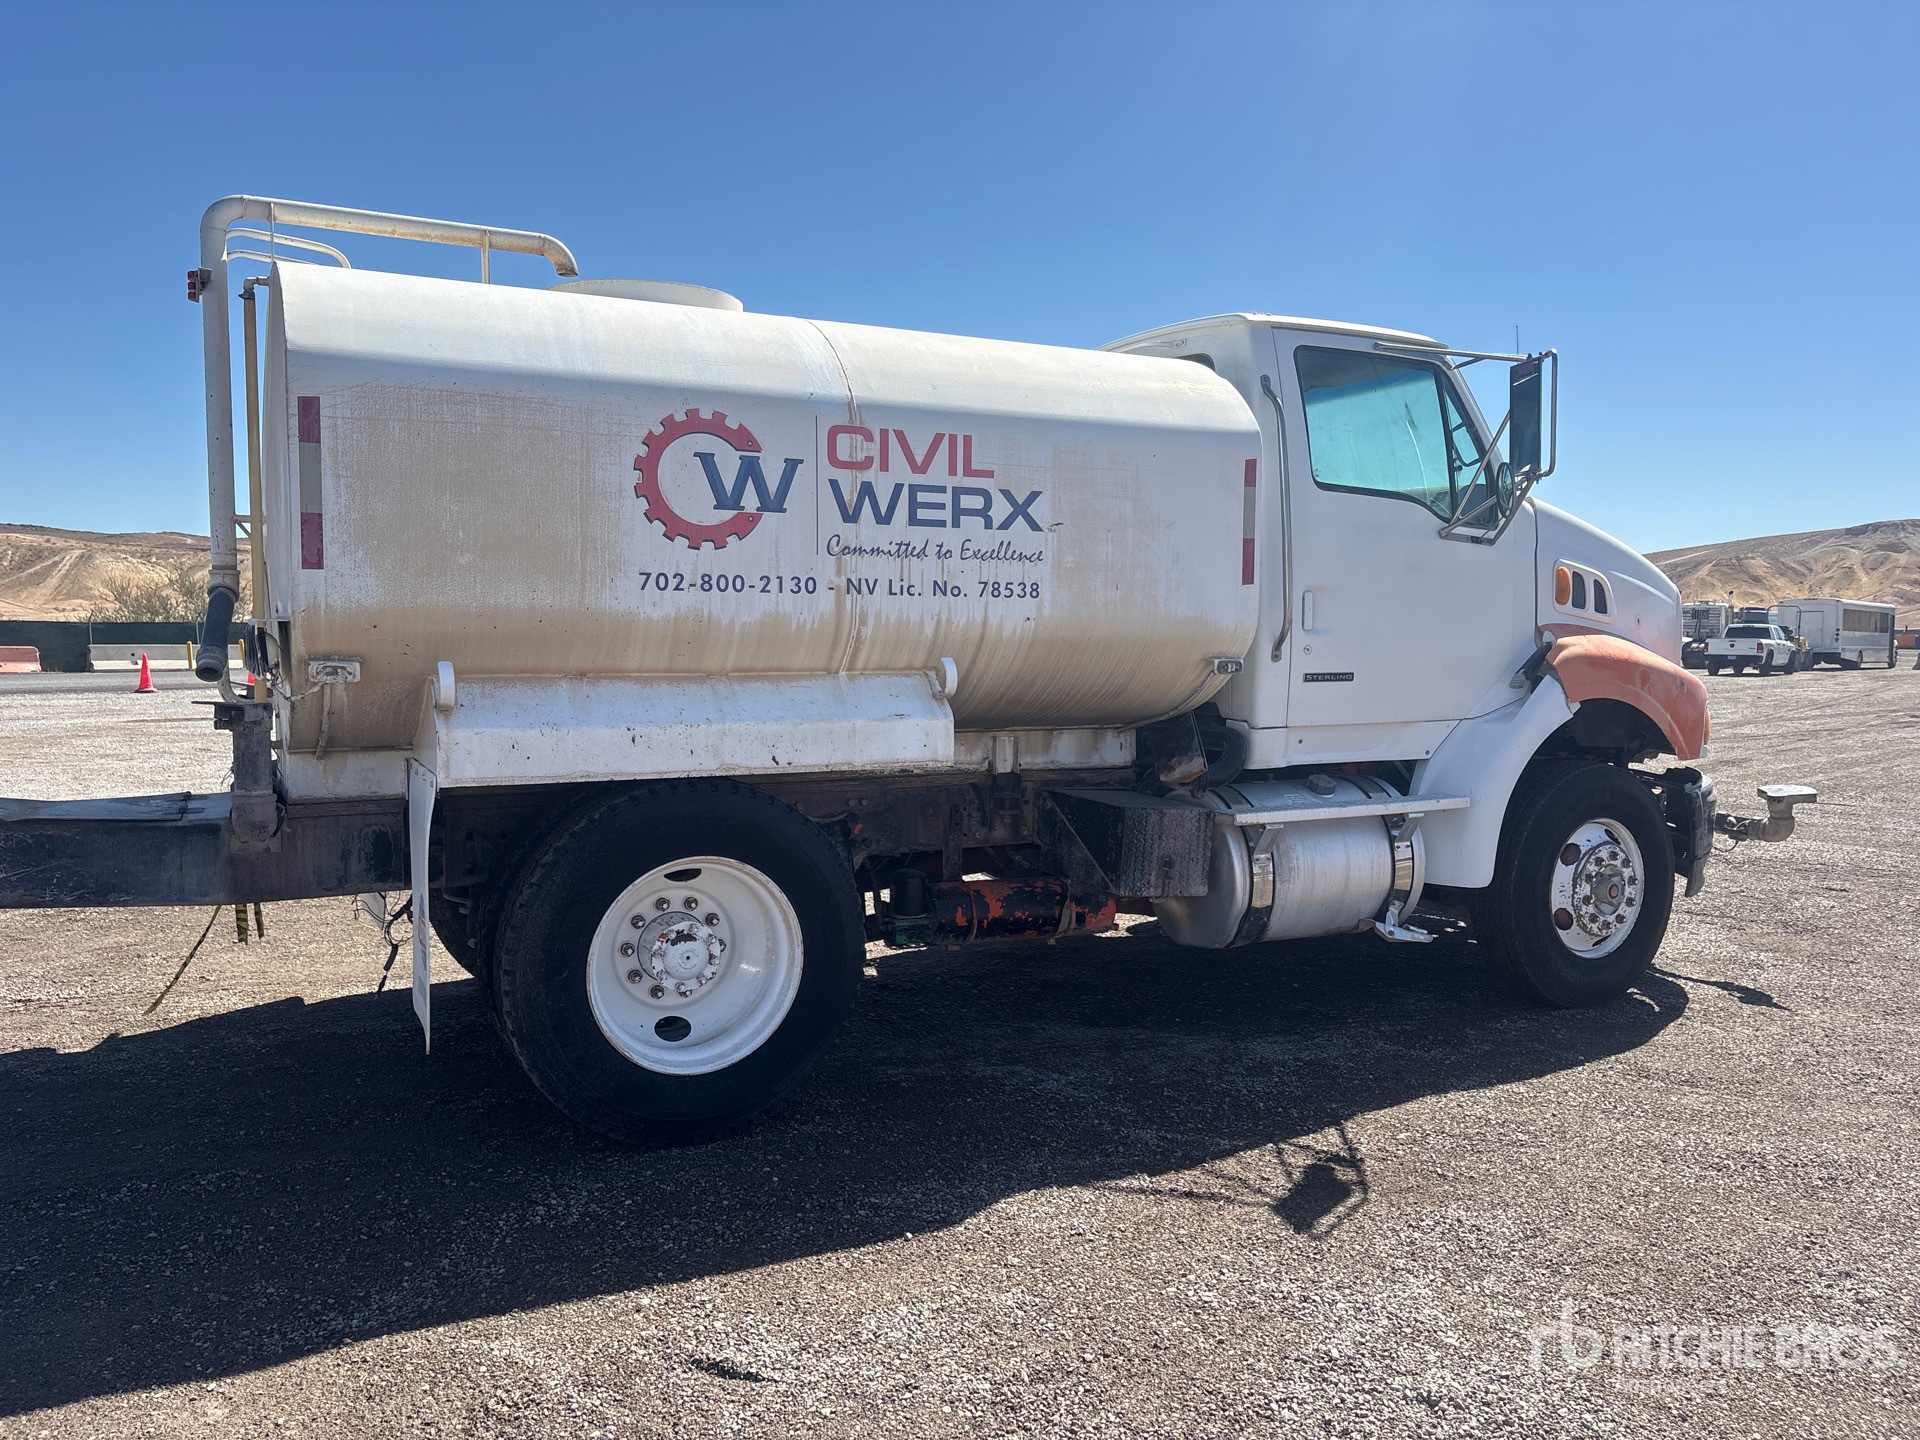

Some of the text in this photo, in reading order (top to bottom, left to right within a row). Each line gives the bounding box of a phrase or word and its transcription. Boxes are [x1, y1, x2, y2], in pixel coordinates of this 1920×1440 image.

[827, 424, 995, 479] CIVIL
[828, 478, 1044, 532] WERX
[827, 534, 1045, 563] Committed to Excellence
[639, 573, 817, 595] 702-800-2130
[846, 578, 879, 597] NV
[888, 578, 922, 597] Lic.
[932, 580, 968, 598] No.
[978, 581, 1041, 599] 78538
